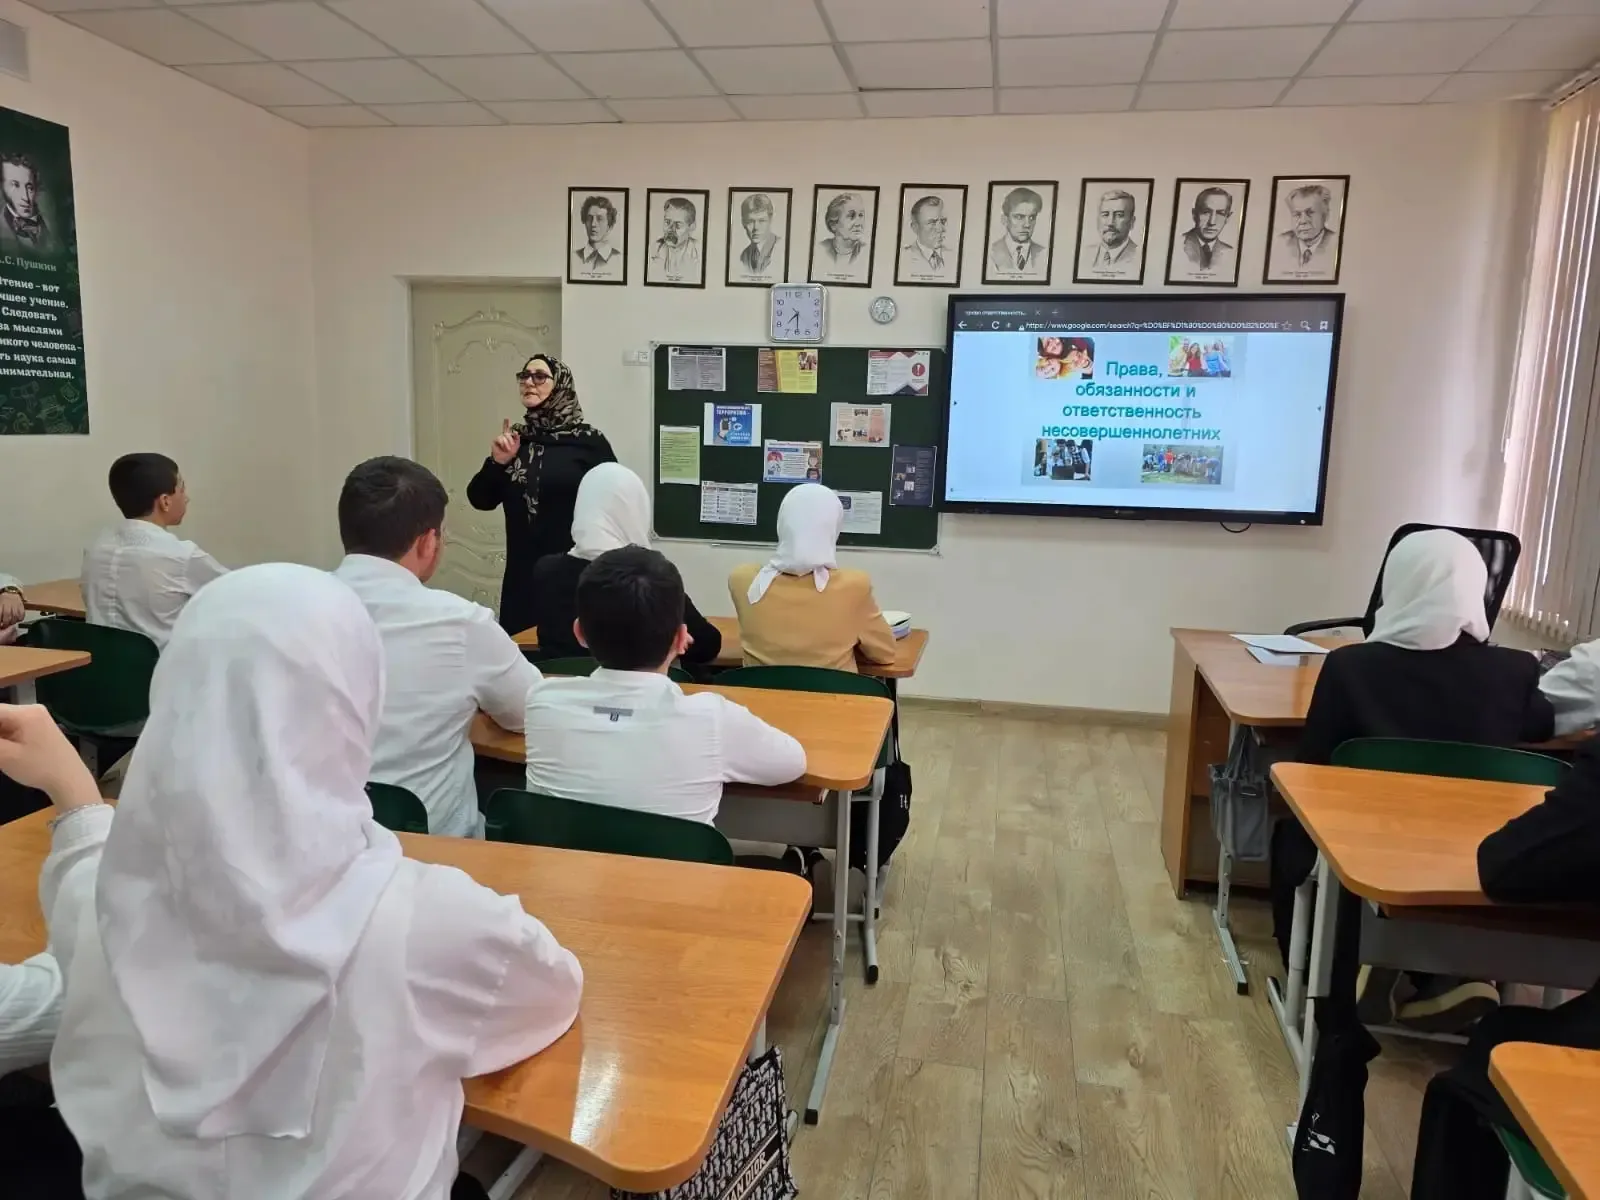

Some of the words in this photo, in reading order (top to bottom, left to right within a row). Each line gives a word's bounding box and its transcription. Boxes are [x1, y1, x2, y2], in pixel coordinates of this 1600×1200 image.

[0, 255, 15, 265] .С.
[17, 257, 57, 272] Пушкин
[42, 283, 60, 293] вот
[29, 296, 69, 309] учение.
[1, 306, 58, 321] Следовать
[12, 324, 63, 336] мыслями
[13, 354, 44, 365] наука
[46, 356, 77, 365] самая
[1106, 361, 1163, 379] Права,
[1075, 382, 1181, 398] обязанности
[1186, 386, 1196, 398] и
[1062, 404, 1202, 419] ответственность
[1041, 424, 1221, 441] несовершеннолетних
[745, 1151, 767, 1187] DIOR
